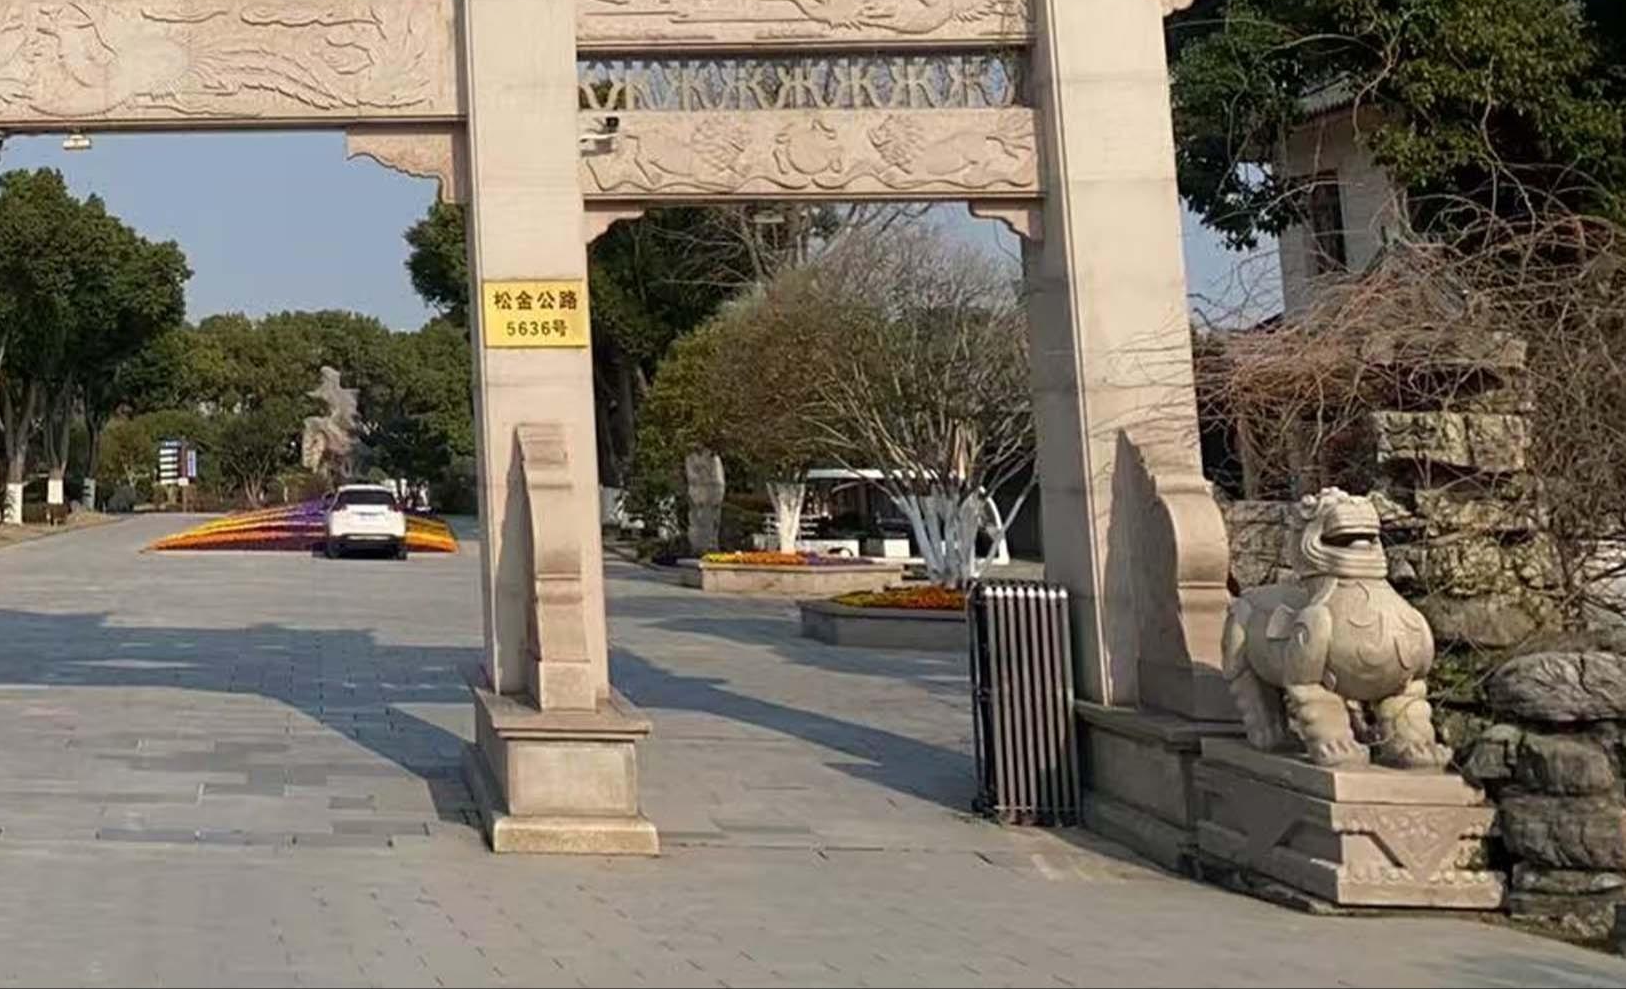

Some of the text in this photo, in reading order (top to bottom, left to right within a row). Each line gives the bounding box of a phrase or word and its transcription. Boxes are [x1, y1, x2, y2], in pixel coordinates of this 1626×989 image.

[493, 290, 577, 310] 松金公路
[506, 319, 568, 337] 5636号
